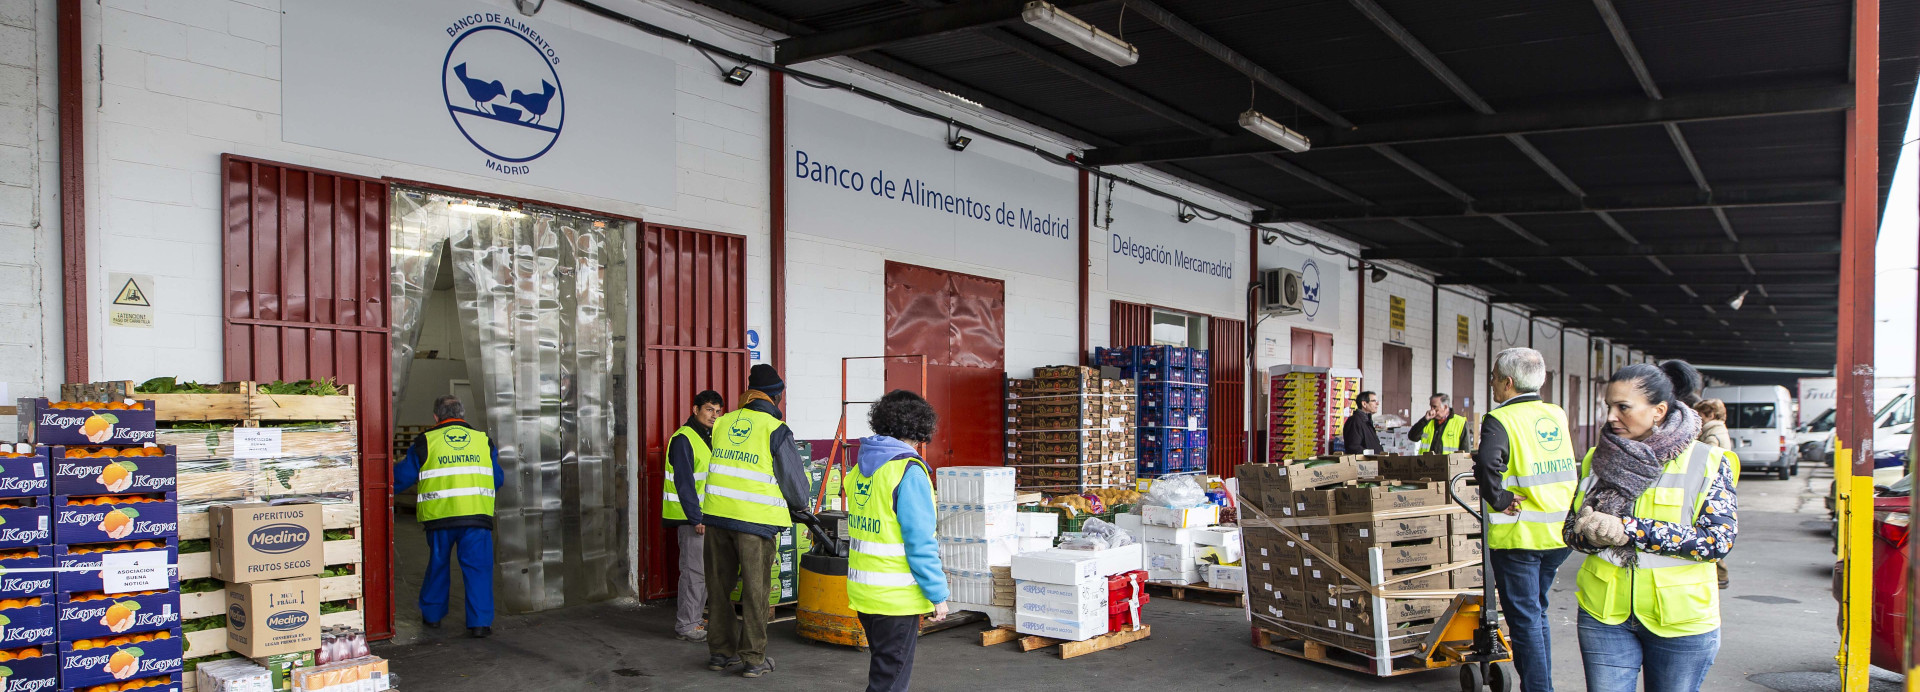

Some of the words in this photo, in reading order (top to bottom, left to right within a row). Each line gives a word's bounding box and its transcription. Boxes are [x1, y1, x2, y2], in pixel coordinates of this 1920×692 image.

[446, 13, 482, 37] BANCO
[486, 13, 502, 23] DE
[504, 17, 560, 65] ALIMENTOS
[485, 159, 530, 175] MADRID
[795, 150, 864, 191] Banco
[870, 170, 895, 199] de
[901, 178, 991, 222] Alimentos
[996, 202, 1015, 227] de
[1019, 208, 1069, 240] Madrid
[1112, 233, 1171, 265] Delegación
[1174, 249, 1232, 279] Mercamadrid
[40, 413, 85, 429] Kaya
[114, 428, 155, 442] Kaya
[437, 454, 480, 464] VOLUNTARIO
[712, 448, 759, 464] VOLUNTARIO
[56, 463, 102, 478] Kaya
[0, 477, 48, 492] Kaya
[133, 475, 176, 489] Kaya
[58, 511, 104, 526] Kaya
[252, 510, 304, 521] APERITIVOS
[1, 528, 49, 543] Kaya
[134, 521, 176, 535] Kaya
[251, 530, 307, 546] Medina
[248, 562, 281, 573] FRUTOS
[284, 560, 311, 570] SECOS
[2, 578, 51, 593] Kaya
[60, 607, 106, 622] Kaya
[136, 612, 178, 626] Kaya
[268, 614, 307, 626] Medina
[5, 627, 53, 642] Kaya
[64, 654, 109, 669] Kaya
[140, 657, 182, 672] Kaya
[8, 677, 55, 692] Kaya
